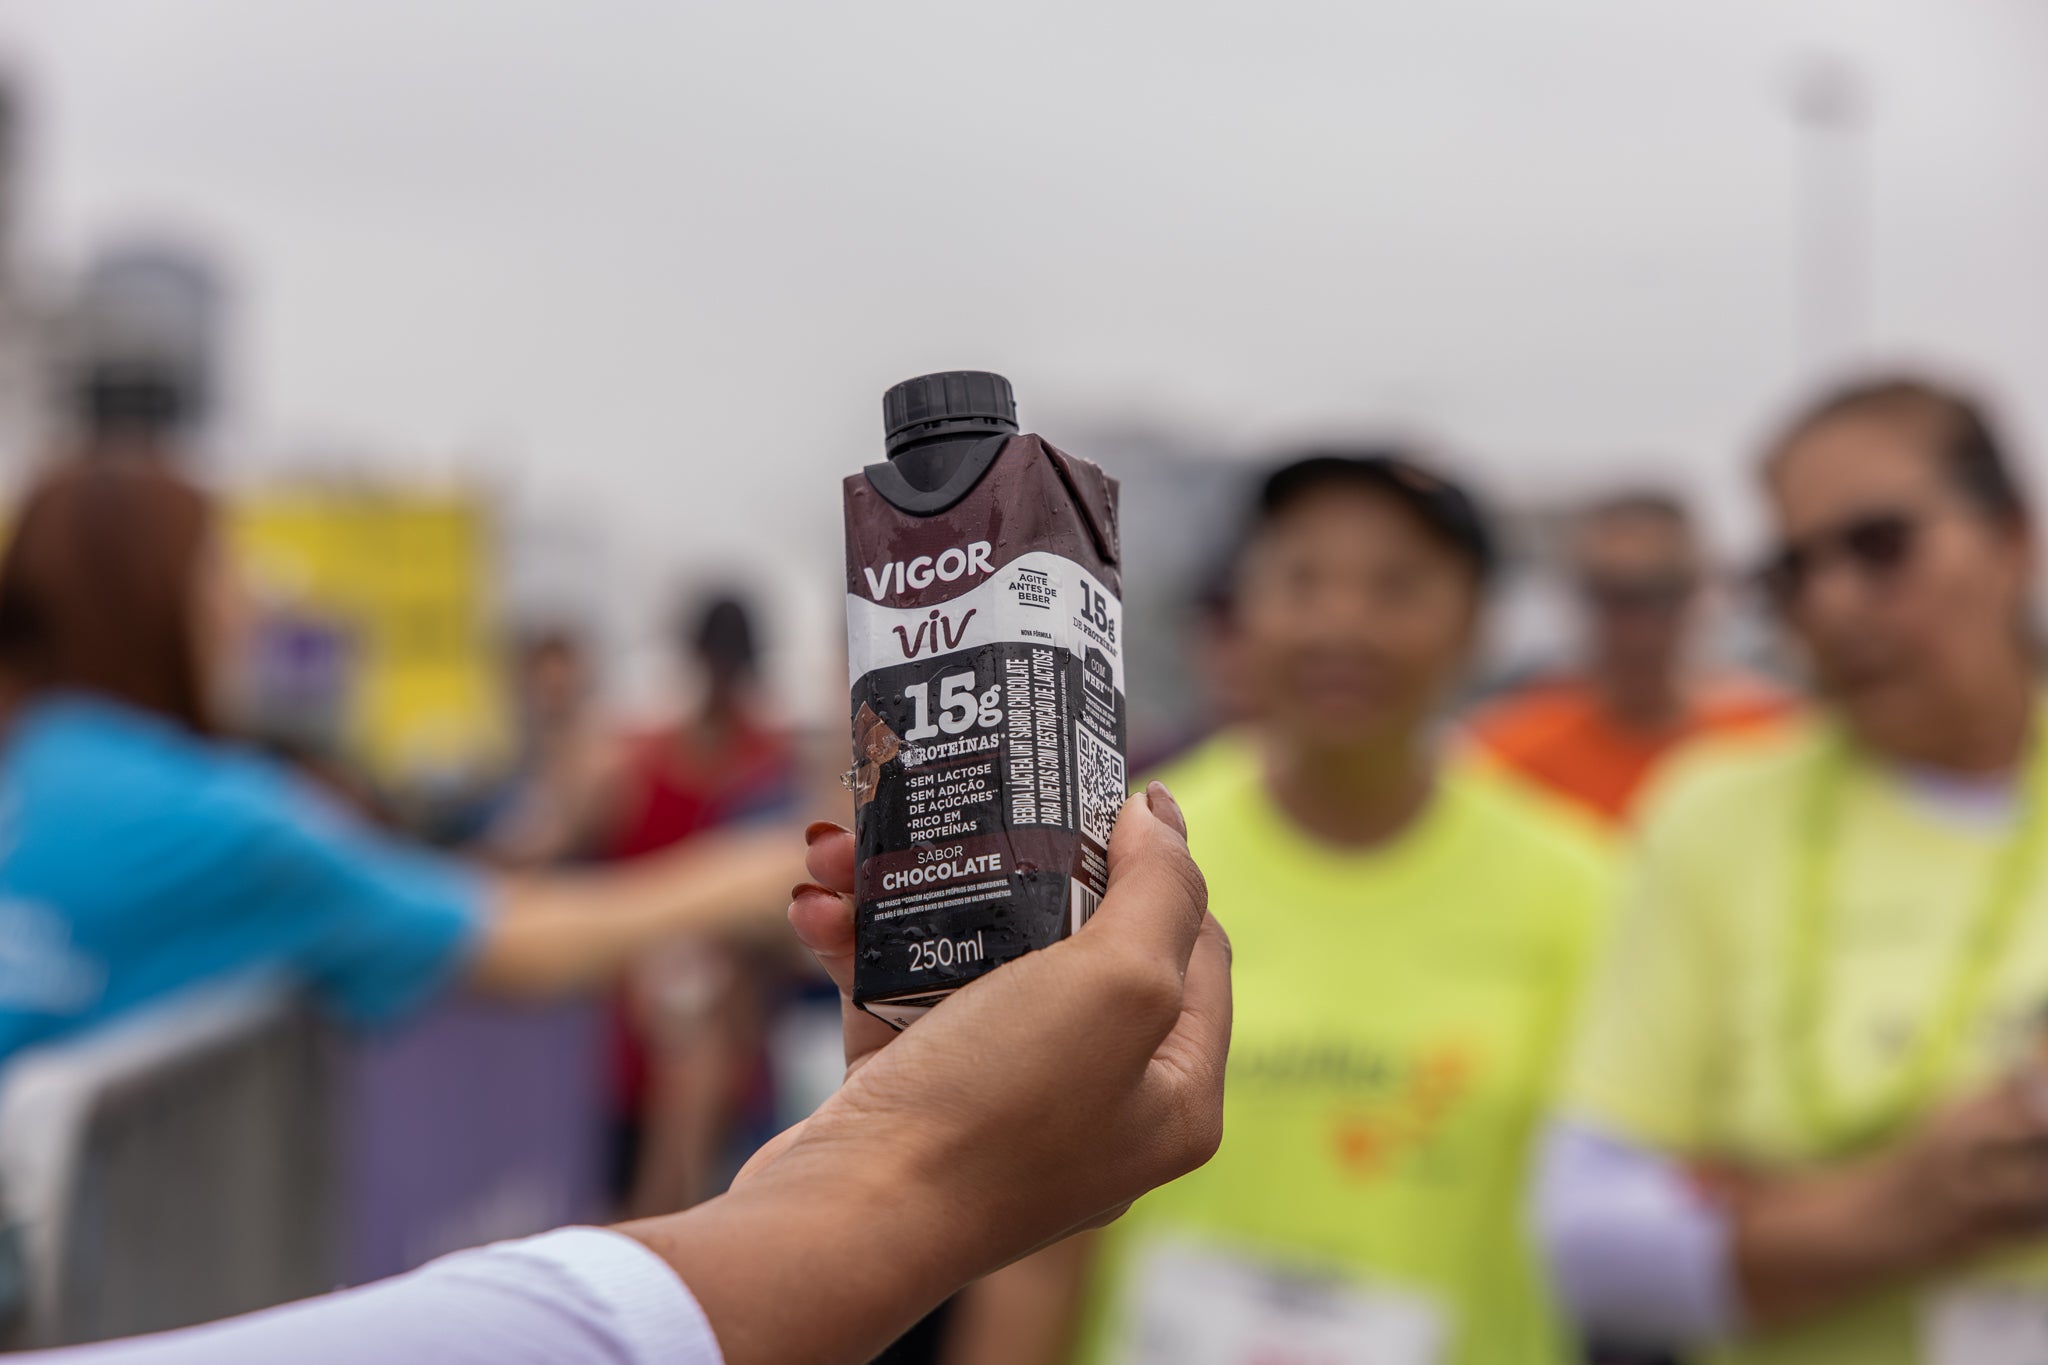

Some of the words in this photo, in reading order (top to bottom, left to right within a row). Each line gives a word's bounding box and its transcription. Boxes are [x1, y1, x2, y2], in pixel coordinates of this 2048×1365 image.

[864, 540, 995, 601] VIGOR
[1019, 574, 1047, 586] AGITE
[1009, 582, 1042, 593] ANTES
[1045, 587, 1057, 597] DE
[1018, 592, 1050, 604] BEBER
[1080, 579, 1116, 644] 15g
[1073, 616, 1083, 630] DE
[1033, 630, 1052, 639] FÓRMULA
[1032, 648, 1054, 688] LACTOSE
[1091, 658, 1106, 678] COM
[1006, 659, 1031, 707] CHOCOLATE
[1034, 687, 1055, 701] DE
[904, 670, 1003, 742] 15g
[1008, 709, 1032, 738] SABOR
[1031, 700, 1061, 749] RESTRIÇÃO
[1082, 710, 1099, 732] Saiba
[1010, 740, 1033, 756] UHT
[1037, 748, 1059, 769] COM
[937, 764, 992, 783] LACTOSE
[1006, 758, 1035, 791] LÁCTEA
[938, 779, 985, 797] ADIÇÃO
[1038, 769, 1061, 801] DIETAS
[909, 803, 926, 815] DE
[944, 810, 961, 823] EM
[1012, 792, 1036, 824] BEBIDA
[1040, 801, 1062, 826] PARA
[910, 820, 977, 842] PROTEÍNAS
[918, 845, 963, 864] SABOR
[882, 853, 1002, 891] CHOCOLATE
[874, 913, 884, 921] ESTE
[908, 930, 984, 972] 250ml
